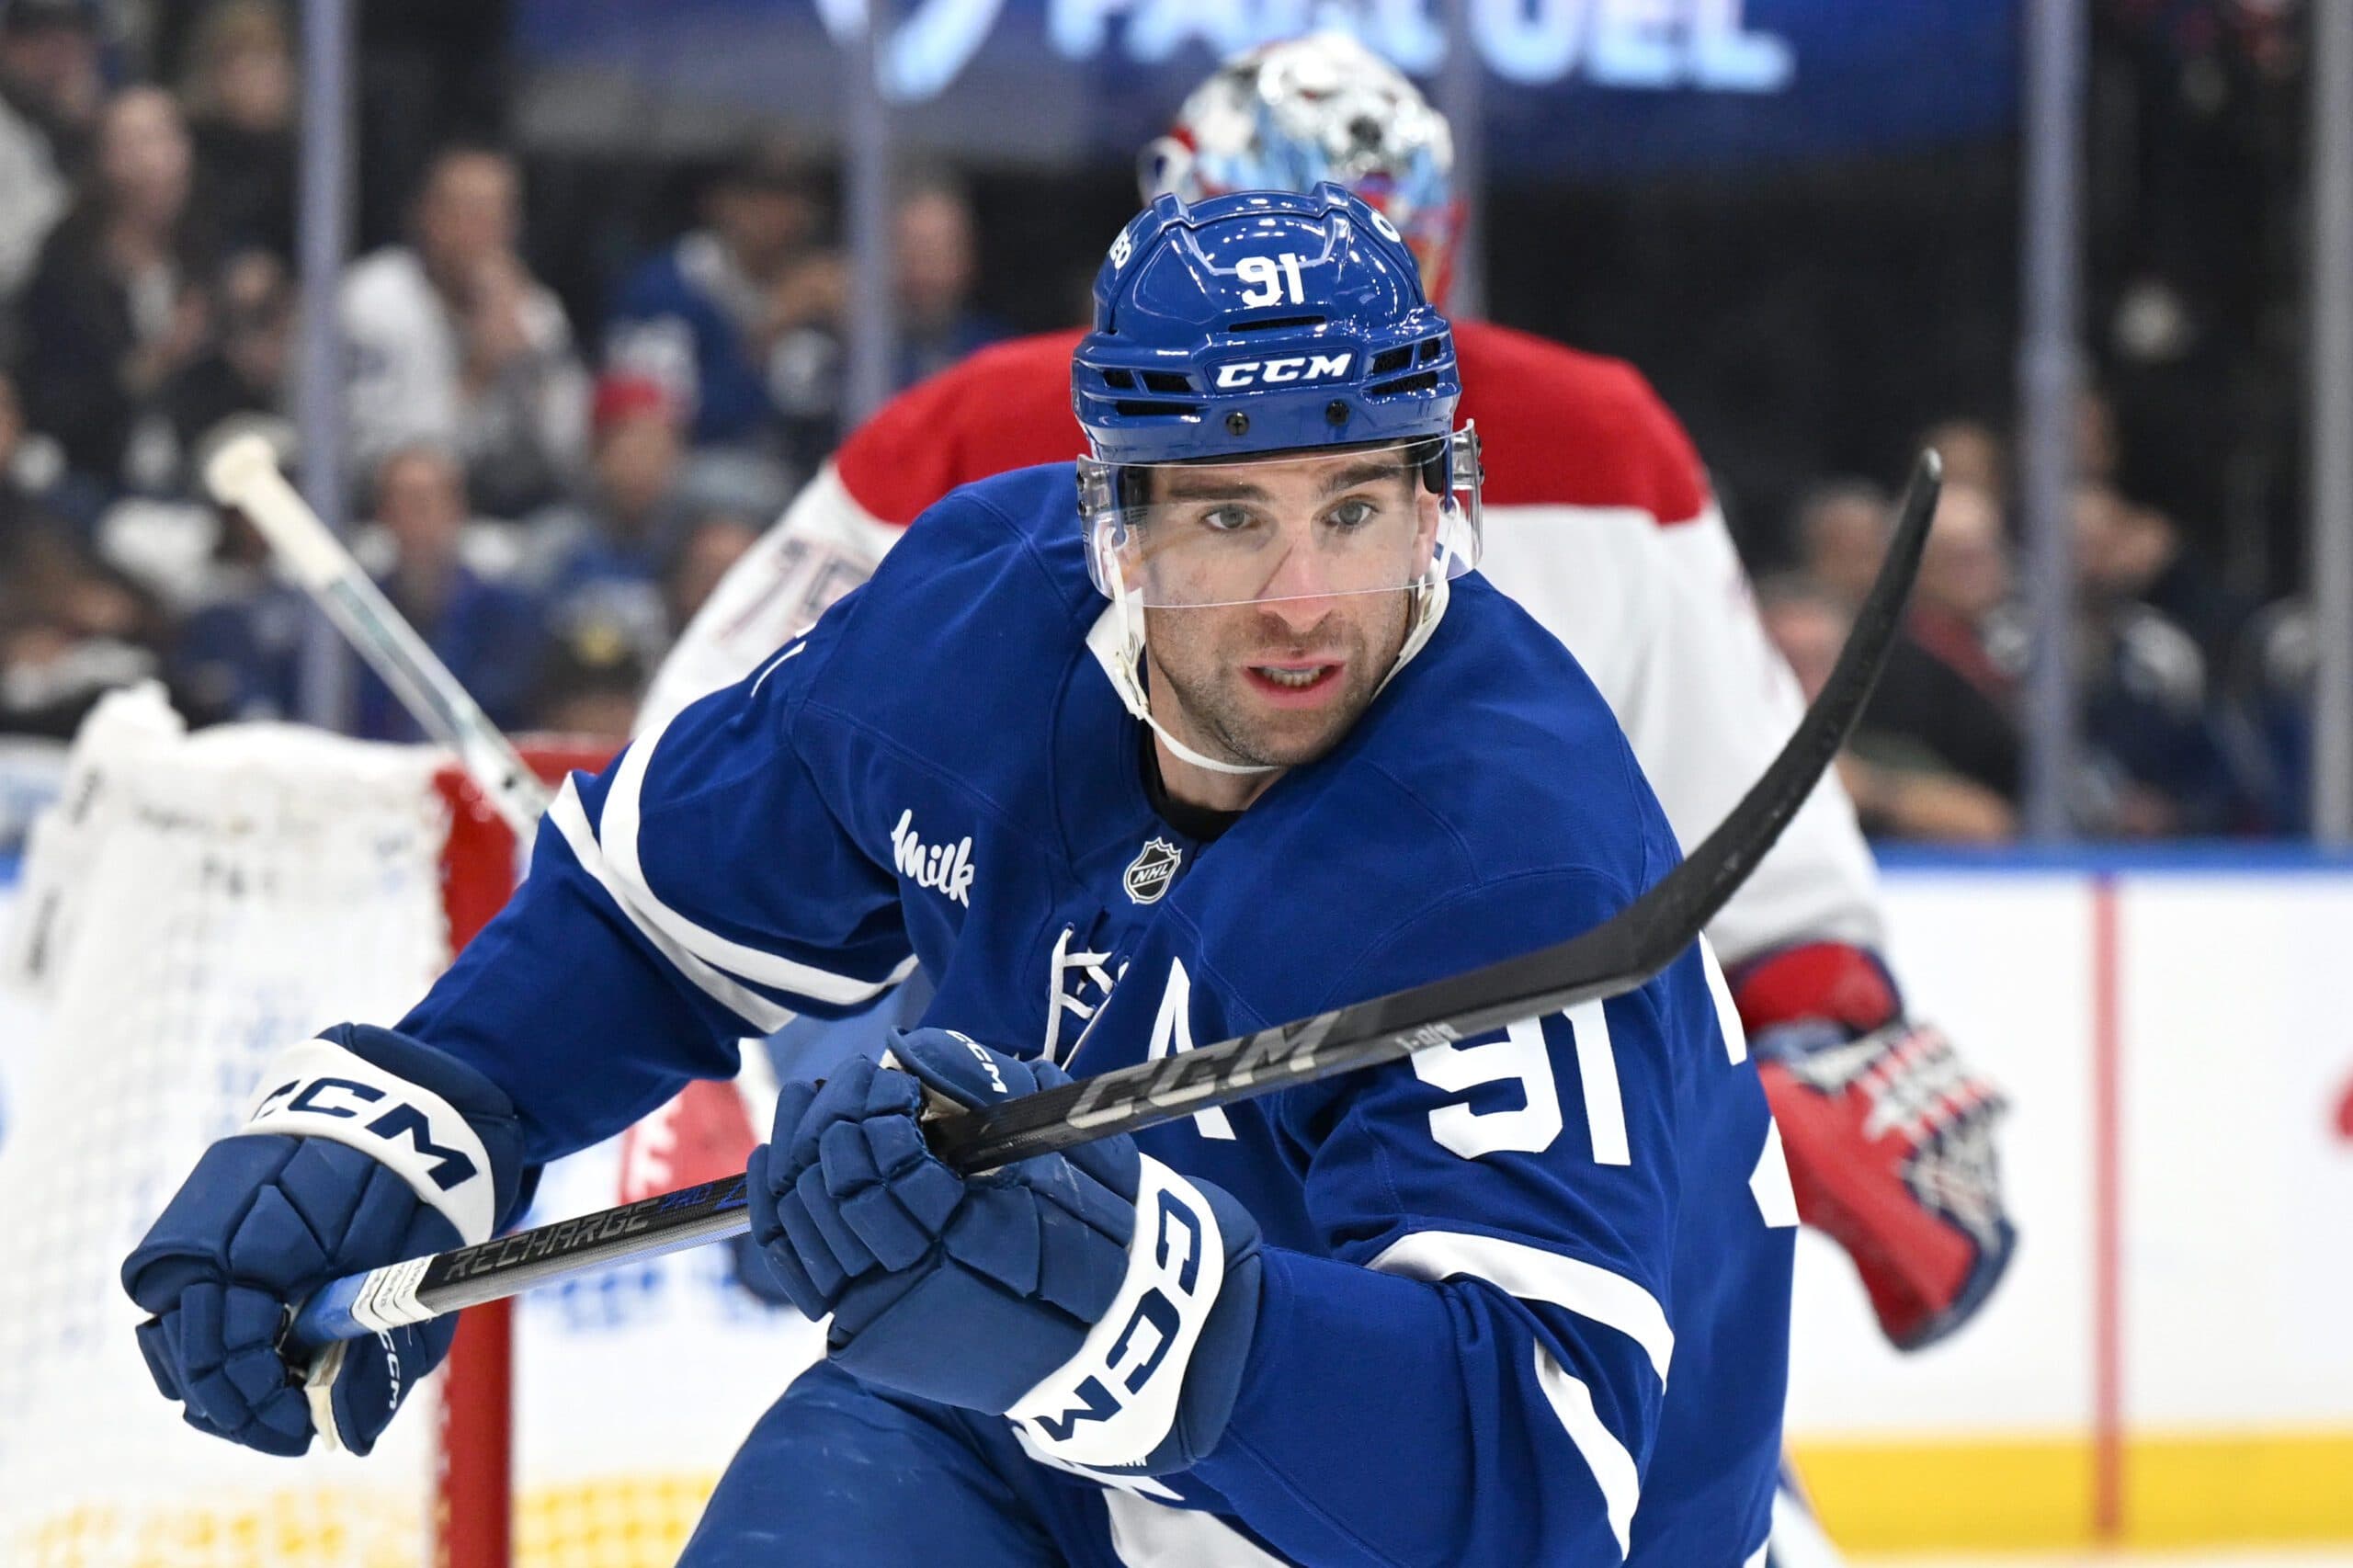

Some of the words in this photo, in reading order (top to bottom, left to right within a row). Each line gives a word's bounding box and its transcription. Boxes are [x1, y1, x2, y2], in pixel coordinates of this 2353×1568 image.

[1235, 253, 1305, 307] 91
[1215, 353, 1352, 389] CCM
[891, 809, 974, 909] Milk
[1132, 863, 1169, 884] NHL
[946, 1029, 1008, 1094] CCM
[1066, 1011, 1341, 1129] CCM
[1409, 997, 1631, 1165] 91
[251, 1077, 478, 1192] CCM
[443, 1198, 660, 1282] RECHARGE
[1031, 1187, 1202, 1442] CCM
[378, 1329, 401, 1410] CCM
